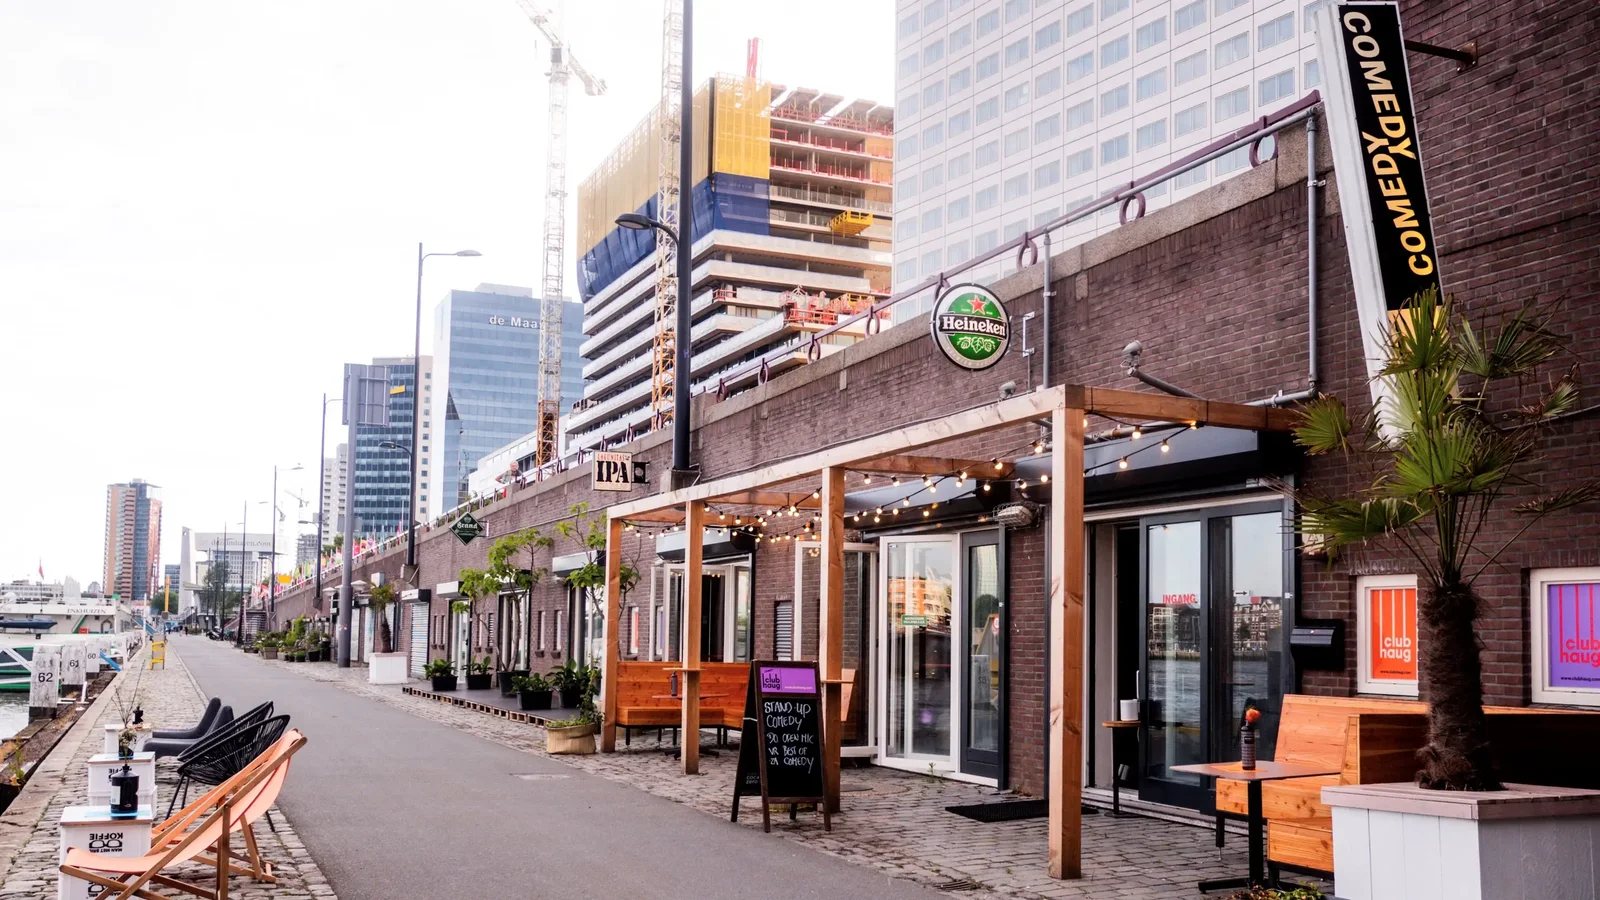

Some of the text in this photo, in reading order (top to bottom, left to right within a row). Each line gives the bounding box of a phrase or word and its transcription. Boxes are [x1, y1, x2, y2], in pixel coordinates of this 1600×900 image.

[1343, 11, 1416, 160] COMEDY
[1361, 131, 1434, 276] COMEDY
[489, 315, 505, 326] de
[942, 316, 1006, 337] Heineken
[596, 460, 630, 484] IPA
[1162, 593, 1197, 604] INGANG
[38, 672, 54, 683] 62
[766, 714, 803, 731] COMEDY
[782, 733, 799, 744] OPEN
[768, 745, 808, 756] VR BEST OF
[783, 757, 814, 774] COMEDY
[89, 832, 123, 840] KOFFIE
